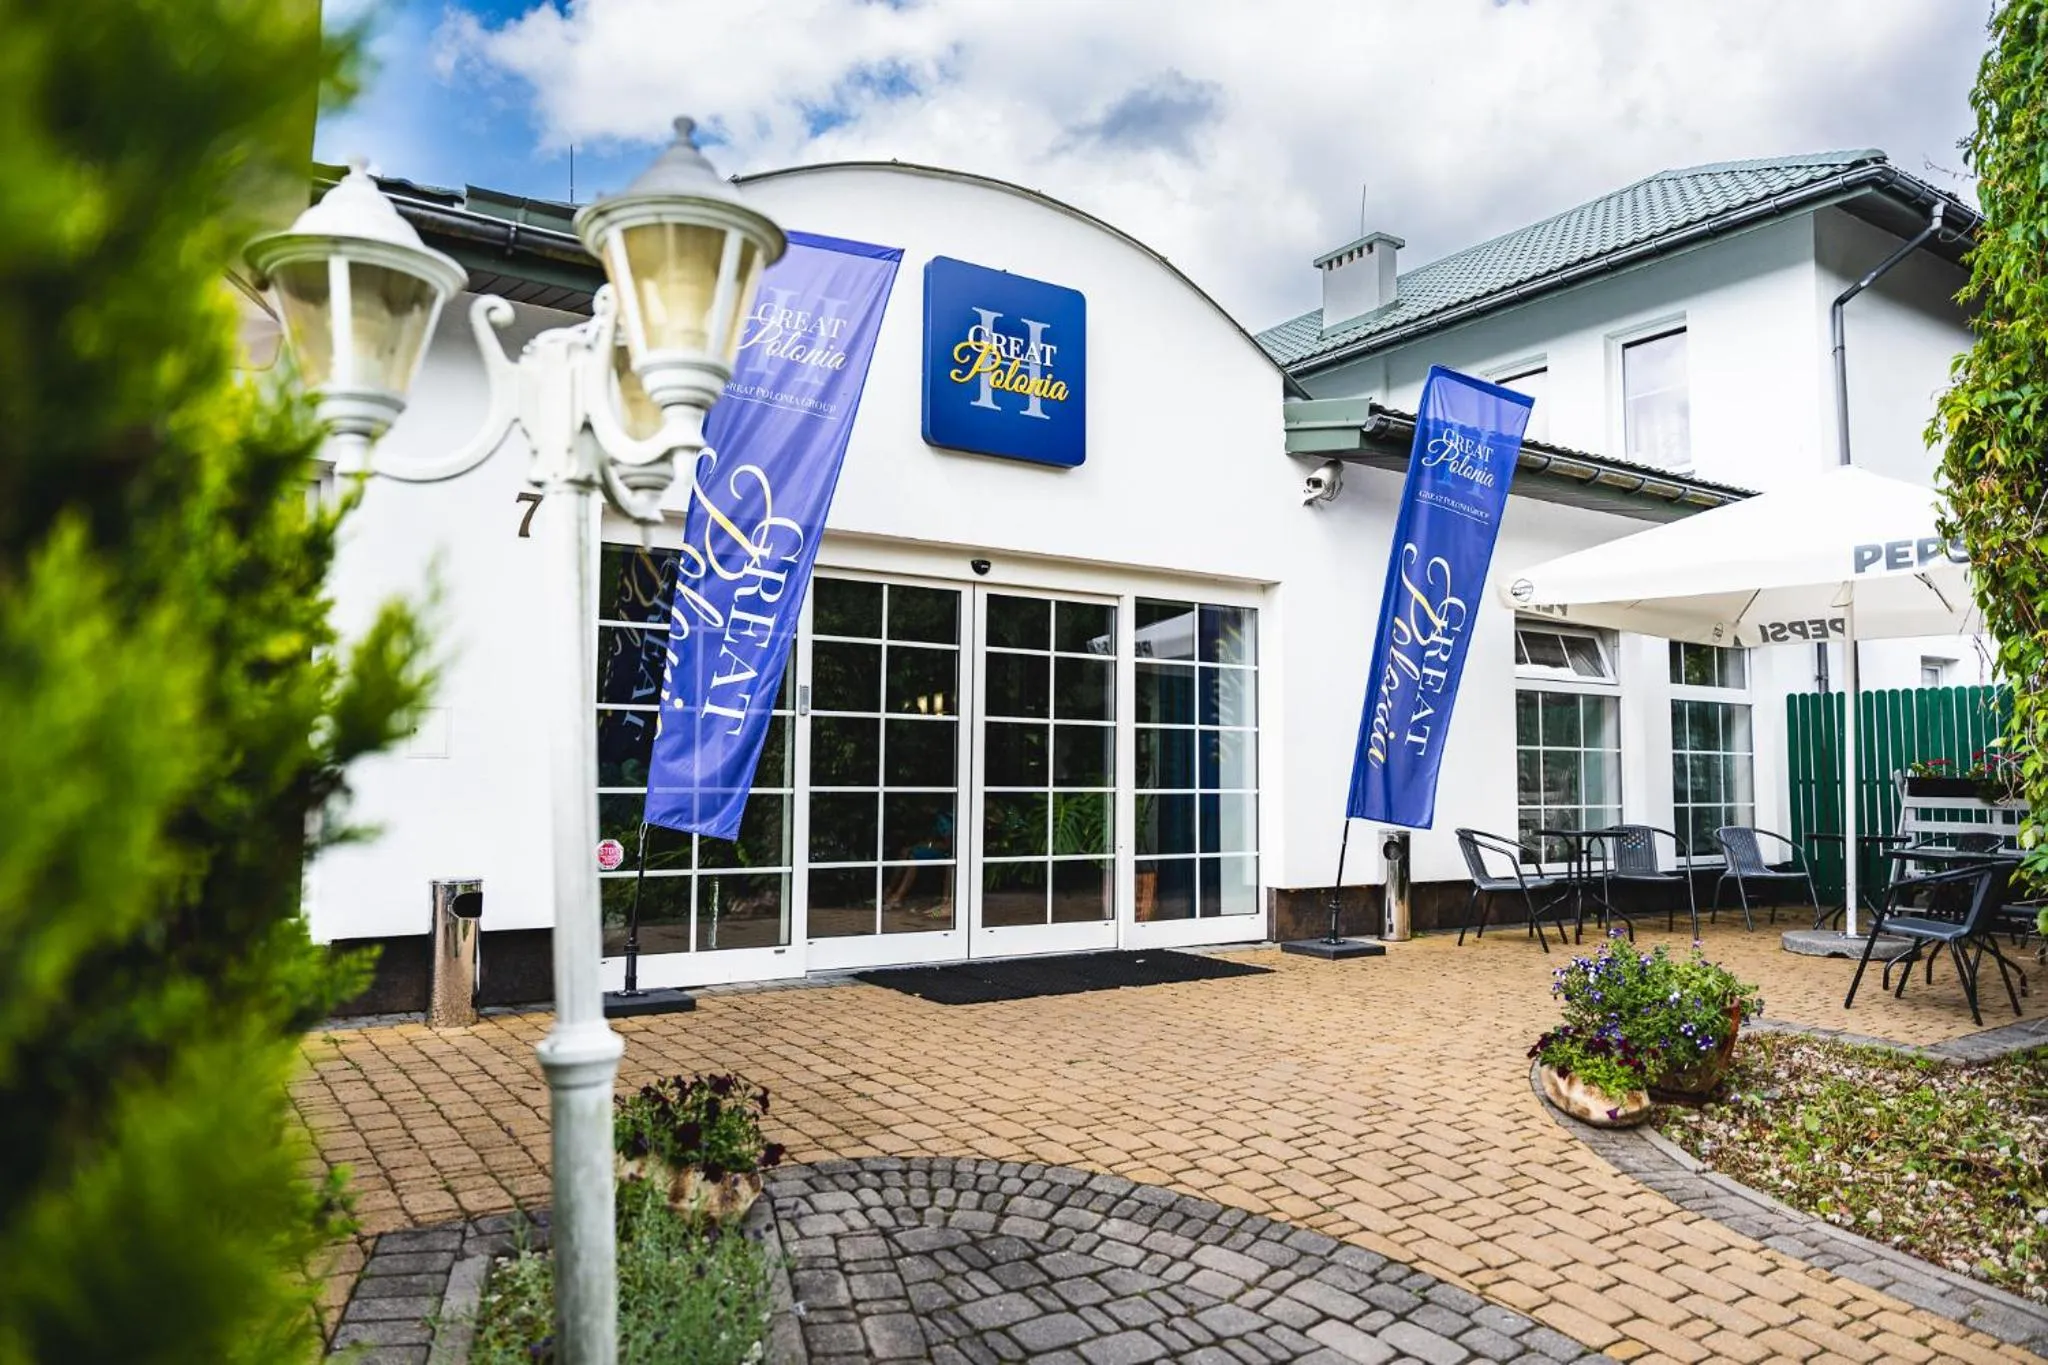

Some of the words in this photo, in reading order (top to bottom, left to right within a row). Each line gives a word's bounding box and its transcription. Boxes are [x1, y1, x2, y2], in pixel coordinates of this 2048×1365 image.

[737, 316, 848, 371] Polonia
[757, 302, 848, 339] GREAT
[967, 324, 1057, 367] GREAT
[725, 381, 757, 397] REAT
[949, 341, 1070, 401] Polonia
[1421, 438, 1495, 488] Polonia
[1442, 427, 1494, 463] GREAT
[516, 492, 543, 538] 7
[1853, 536, 1973, 574] PEPS
[701, 517, 804, 737] GREAT
[1368, 542, 1451, 769] Polonia
[1404, 596, 1467, 756] GREAT
